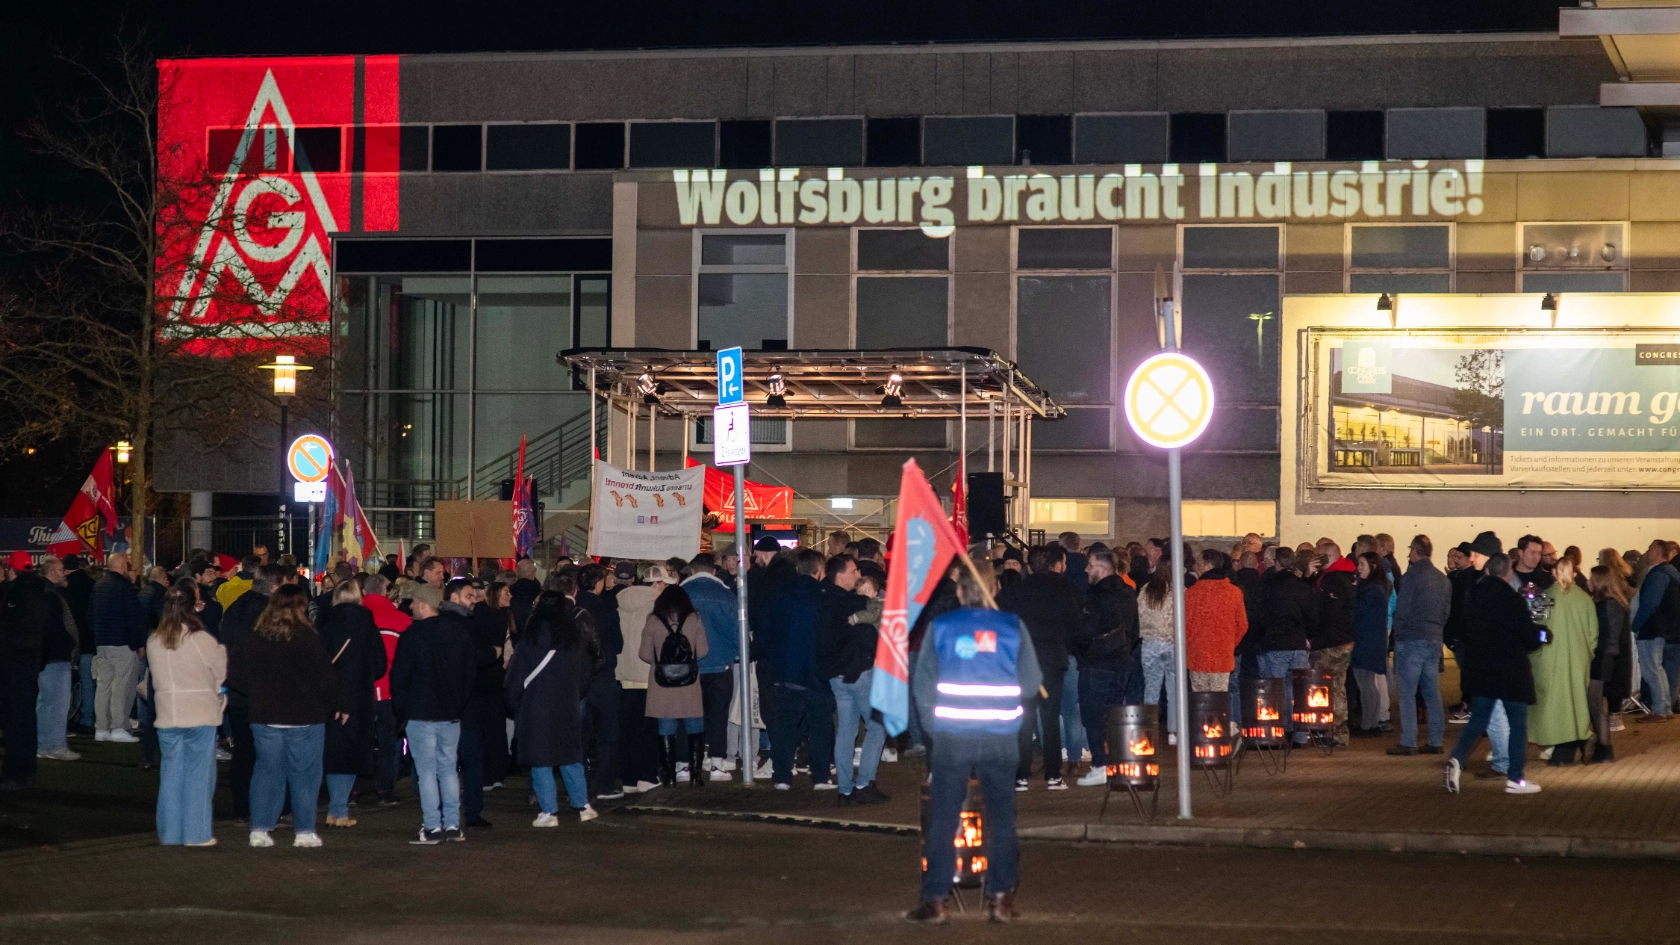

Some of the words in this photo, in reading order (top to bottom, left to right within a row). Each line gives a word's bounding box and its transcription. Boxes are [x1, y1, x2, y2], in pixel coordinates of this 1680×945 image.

[672, 167, 956, 238] Wolfsburg
[967, 163, 1184, 222] braucht
[1199, 159, 1484, 219] Industrie!
[1639, 351, 1680, 359] CONGRE
[721, 356, 735, 398] P
[1520, 391, 1642, 416] raum
[1649, 391, 1680, 425] g
[1520, 427, 1544, 437] EIN
[1550, 427, 1581, 437] ORT.
[1588, 427, 1654, 437] GEMACHT
[1510, 455, 1533, 463] Tickets
[1548, 455, 1597, 463] Informationen
[1510, 465, 1571, 473] Vorverkaufsstellen
[1571, 465, 1586, 473] und
[1586, 466, 1616, 474] jederzeit
